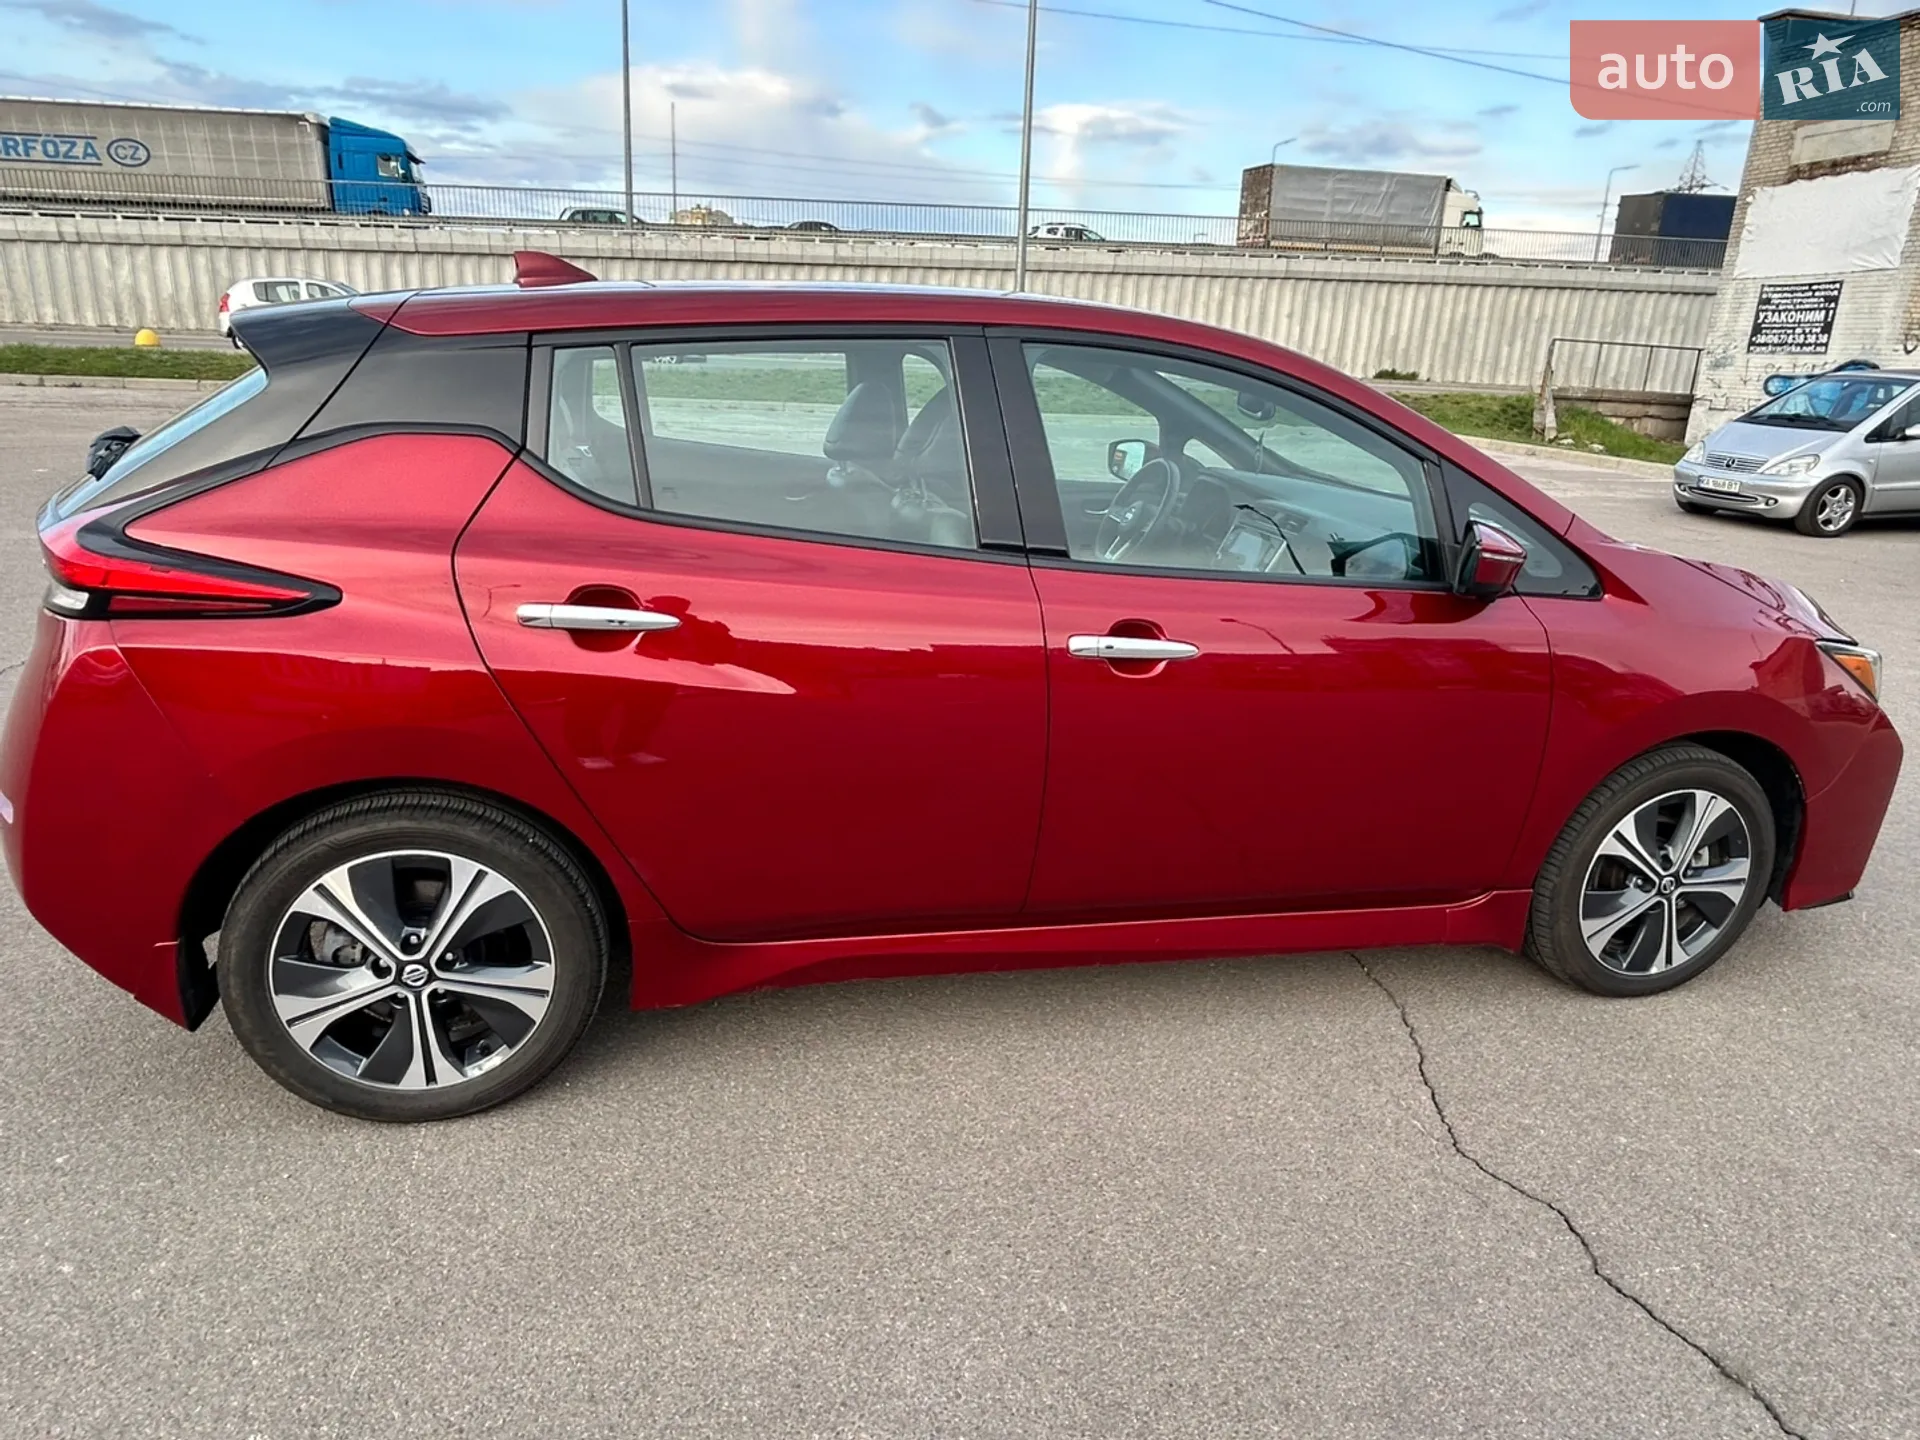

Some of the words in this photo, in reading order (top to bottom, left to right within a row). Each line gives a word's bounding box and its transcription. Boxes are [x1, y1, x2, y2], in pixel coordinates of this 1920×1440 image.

[0, 134, 101, 161] RFÖZA
[114, 144, 143, 162] CZ
[1757, 310, 1826, 323] УЗАКОНИМ
